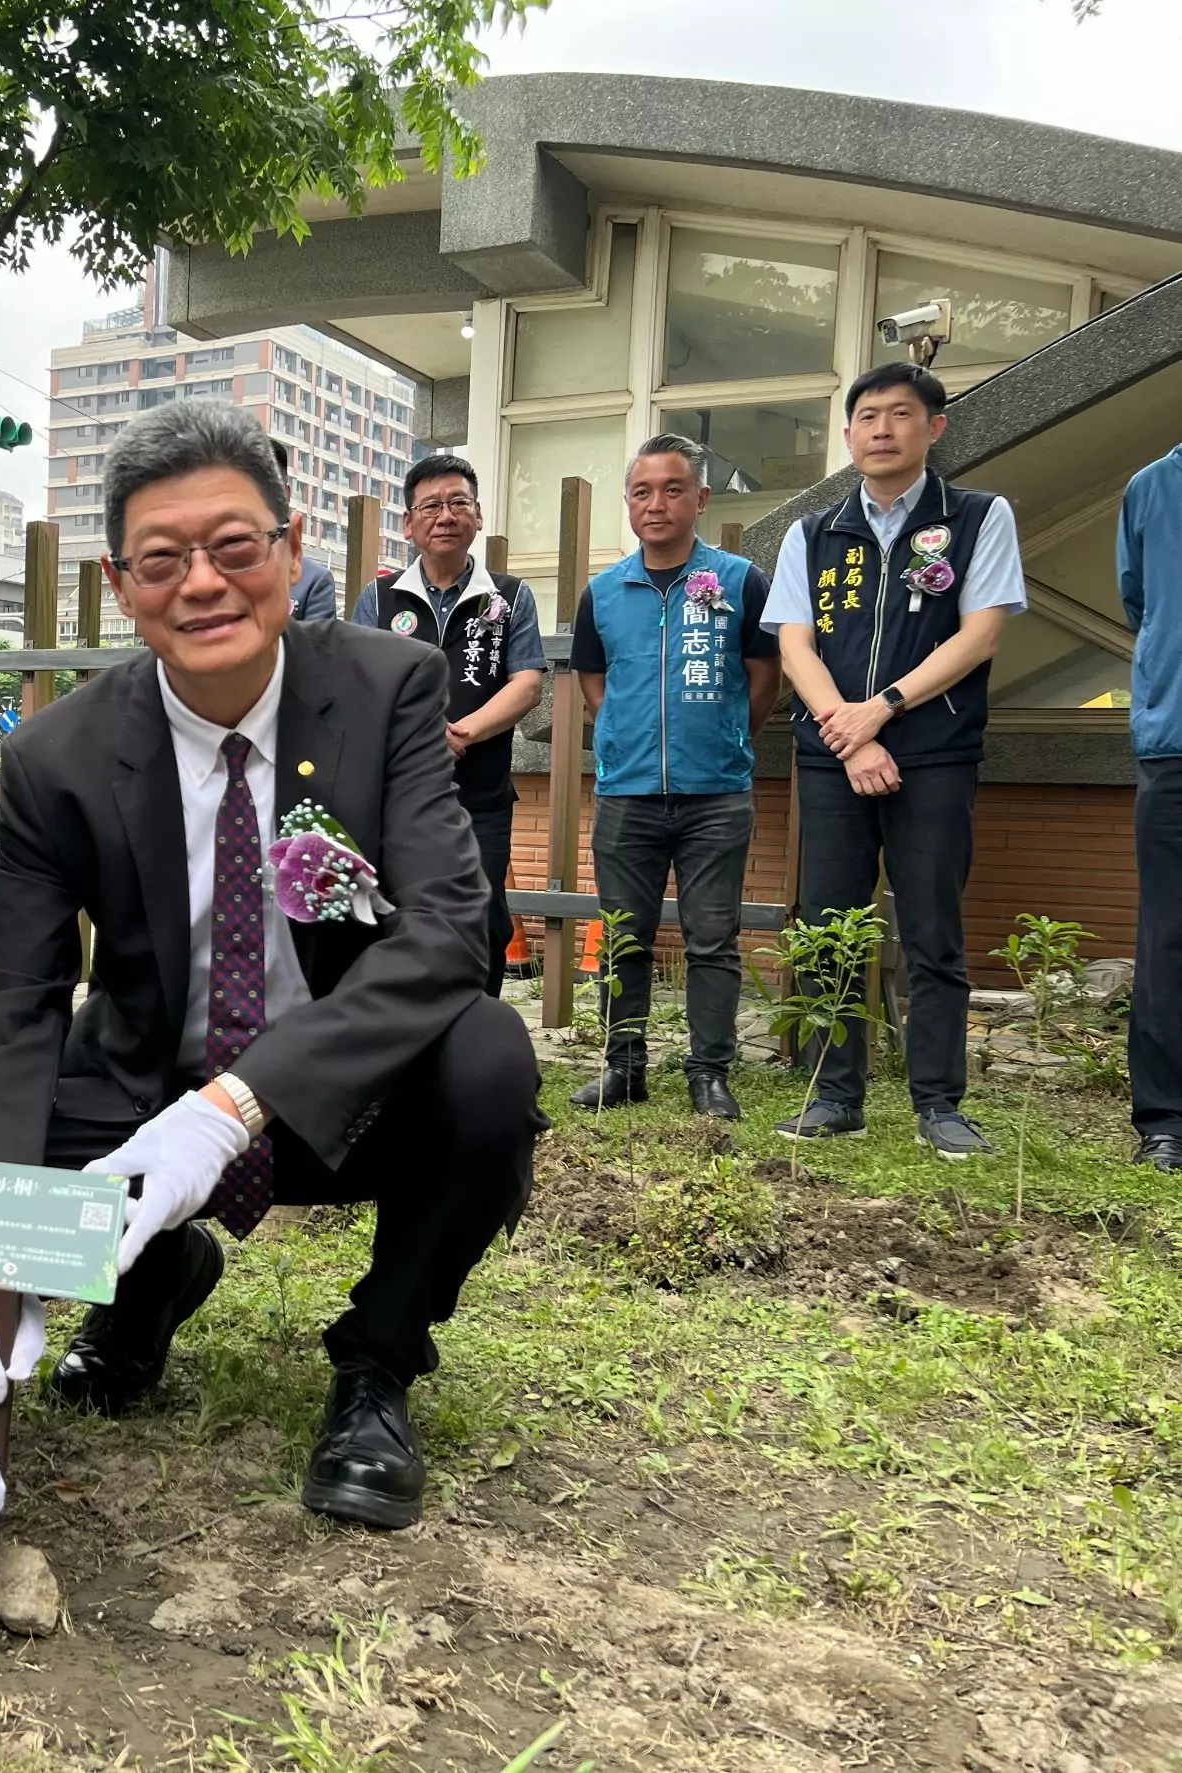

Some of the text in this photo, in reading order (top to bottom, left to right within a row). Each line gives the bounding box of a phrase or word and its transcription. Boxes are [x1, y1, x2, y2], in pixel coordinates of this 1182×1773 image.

[842, 546, 864, 609] 副局長
[488, 617, 503, 678] 園市議員
[682, 600, 710, 686] 簡志偉
[714, 616, 727, 686] 園市議員
